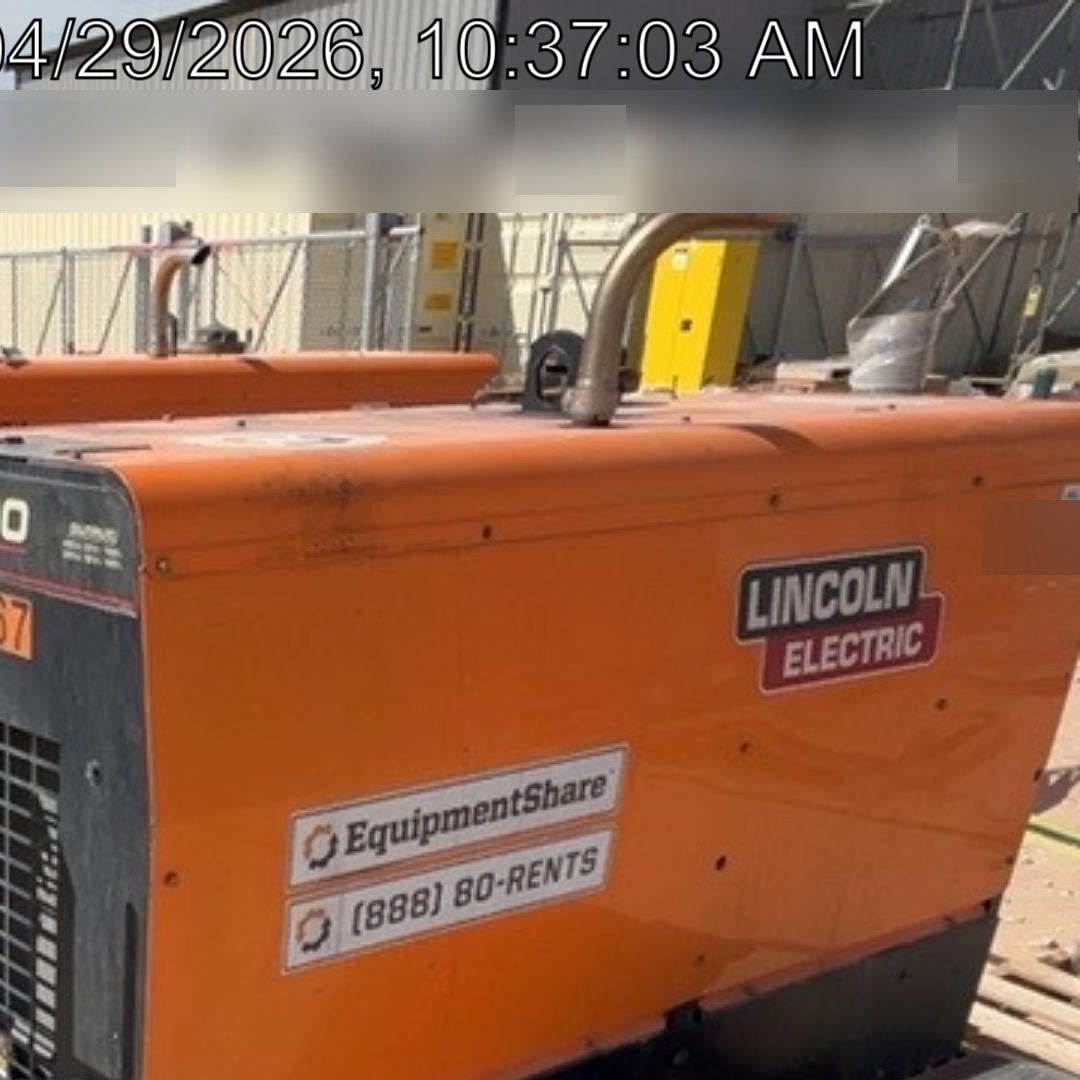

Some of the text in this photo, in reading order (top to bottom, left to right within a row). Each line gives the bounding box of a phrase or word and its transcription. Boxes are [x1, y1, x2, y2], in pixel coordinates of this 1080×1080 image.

[746, 560, 916, 632] LINCOLN
[782, 621, 924, 680] ELECTRIC
[344, 774, 608, 856] EquipmentShare
[351, 846, 599, 937] (888) 80-RENTS
